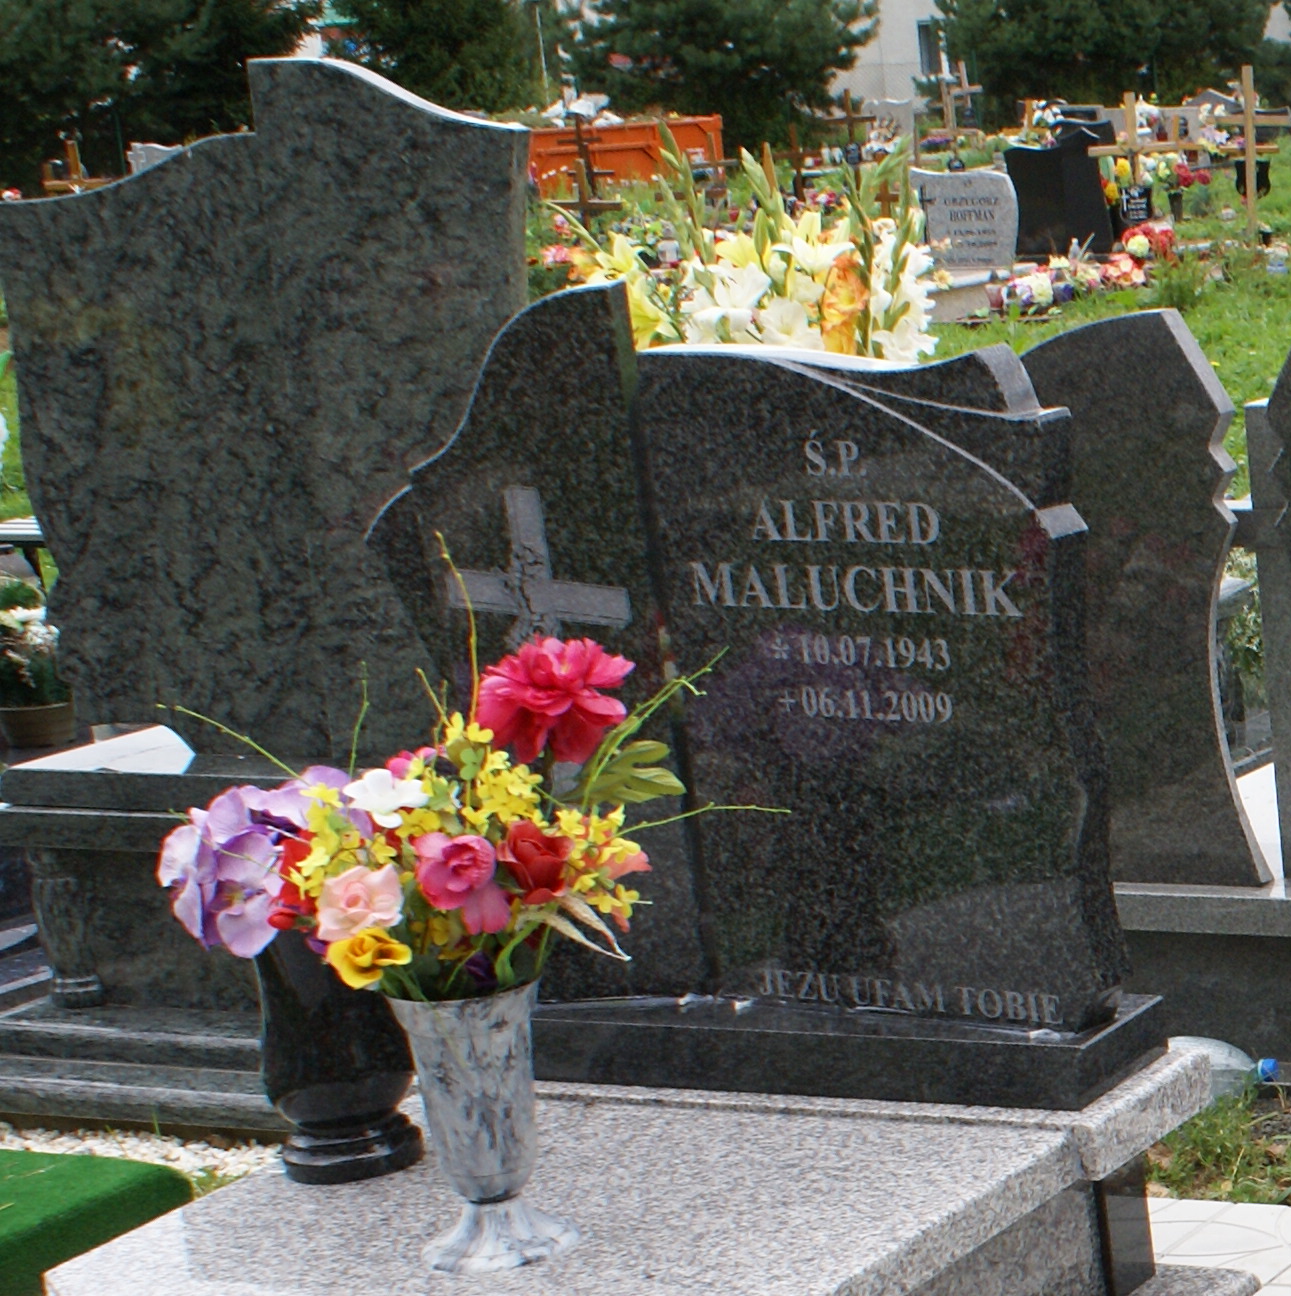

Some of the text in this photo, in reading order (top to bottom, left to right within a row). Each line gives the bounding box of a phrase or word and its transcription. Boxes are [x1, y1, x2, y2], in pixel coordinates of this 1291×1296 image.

[804, 429, 867, 477] Ś.P.
[752, 500, 941, 544] ALFRED
[689, 561, 1024, 617] MALUCHNIK
[800, 686, 953, 723] 06.11.2009
[759, 968, 1064, 1026] JEZU UFAM TOBIE
